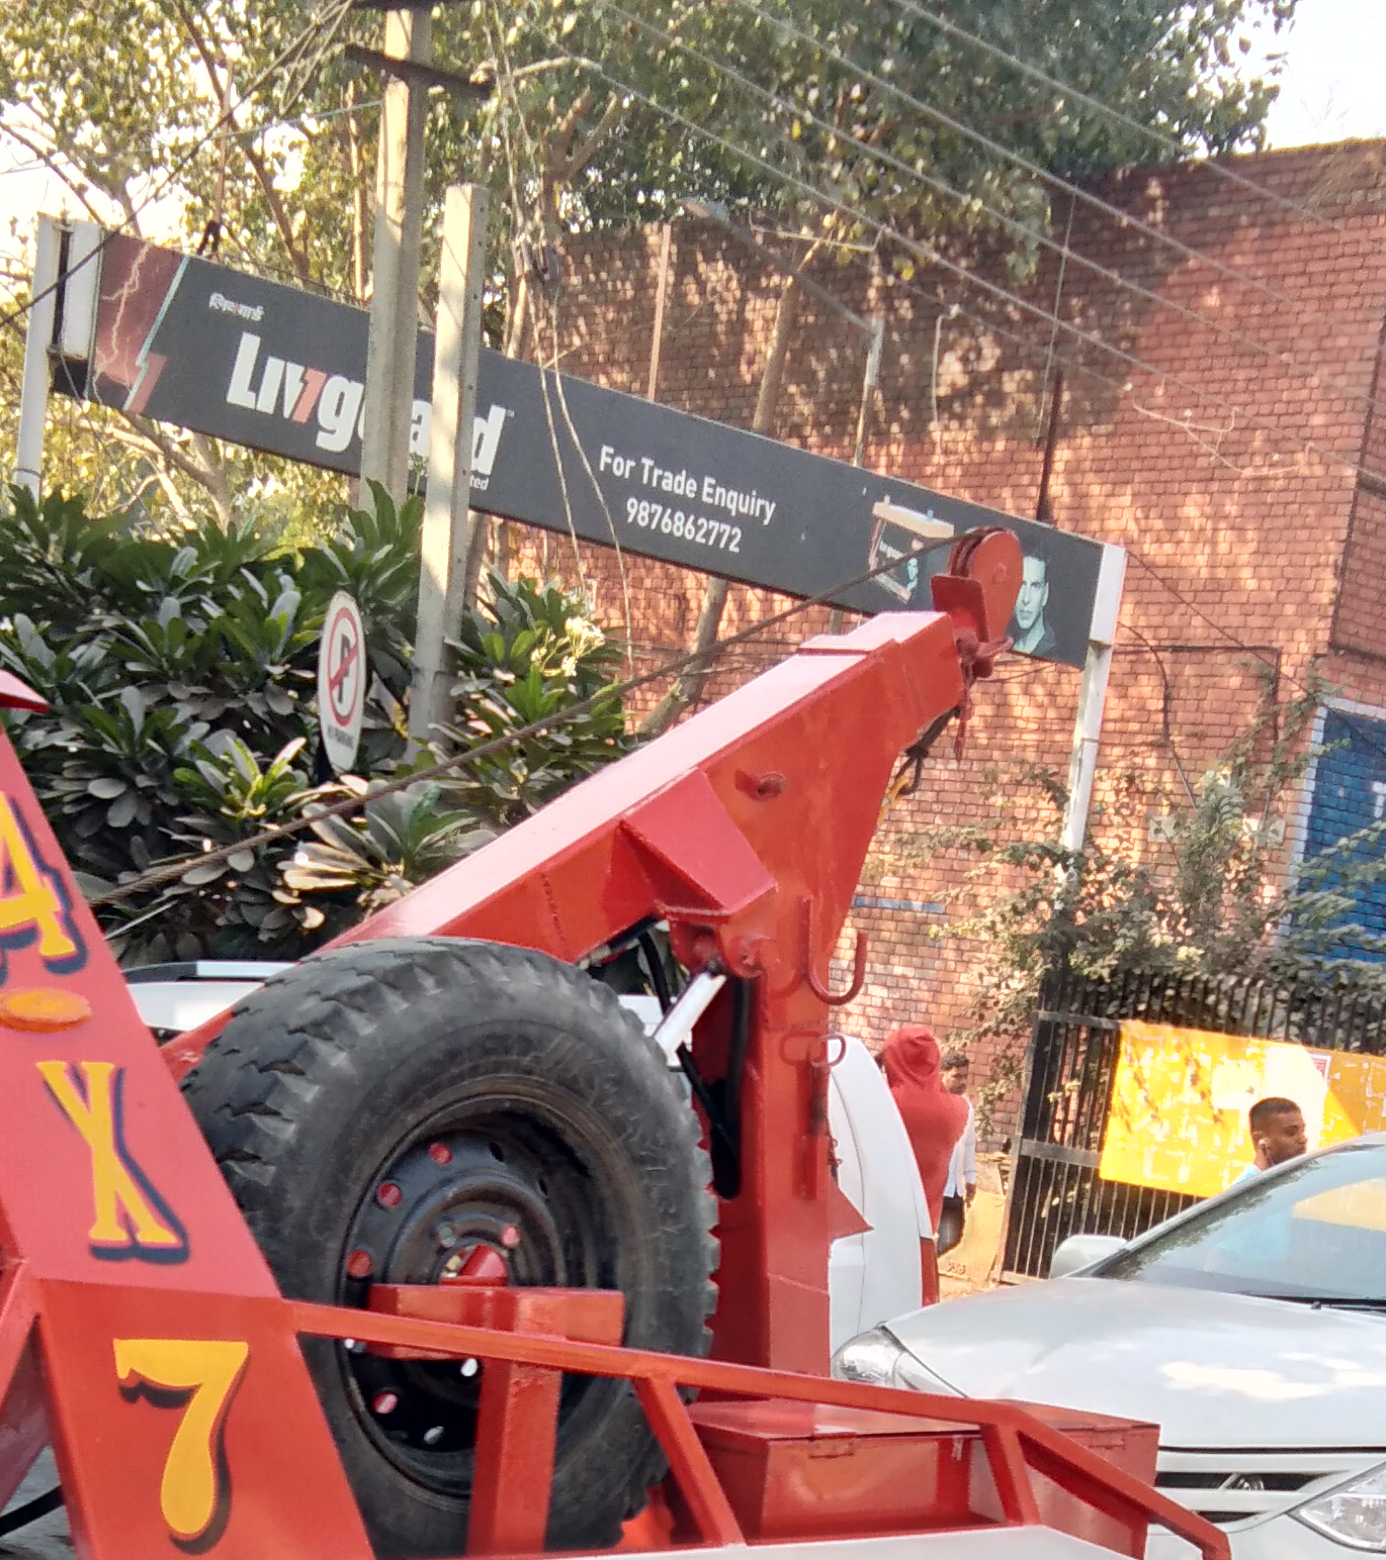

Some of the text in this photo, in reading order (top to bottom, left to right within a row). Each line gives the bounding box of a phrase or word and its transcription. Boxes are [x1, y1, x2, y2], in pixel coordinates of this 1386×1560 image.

[599, 444, 776, 527] For Trade Enquiry
[626, 496, 743, 553] 9876862772
[36, 1061, 188, 1263] X
[113, 1338, 249, 1555] 7
